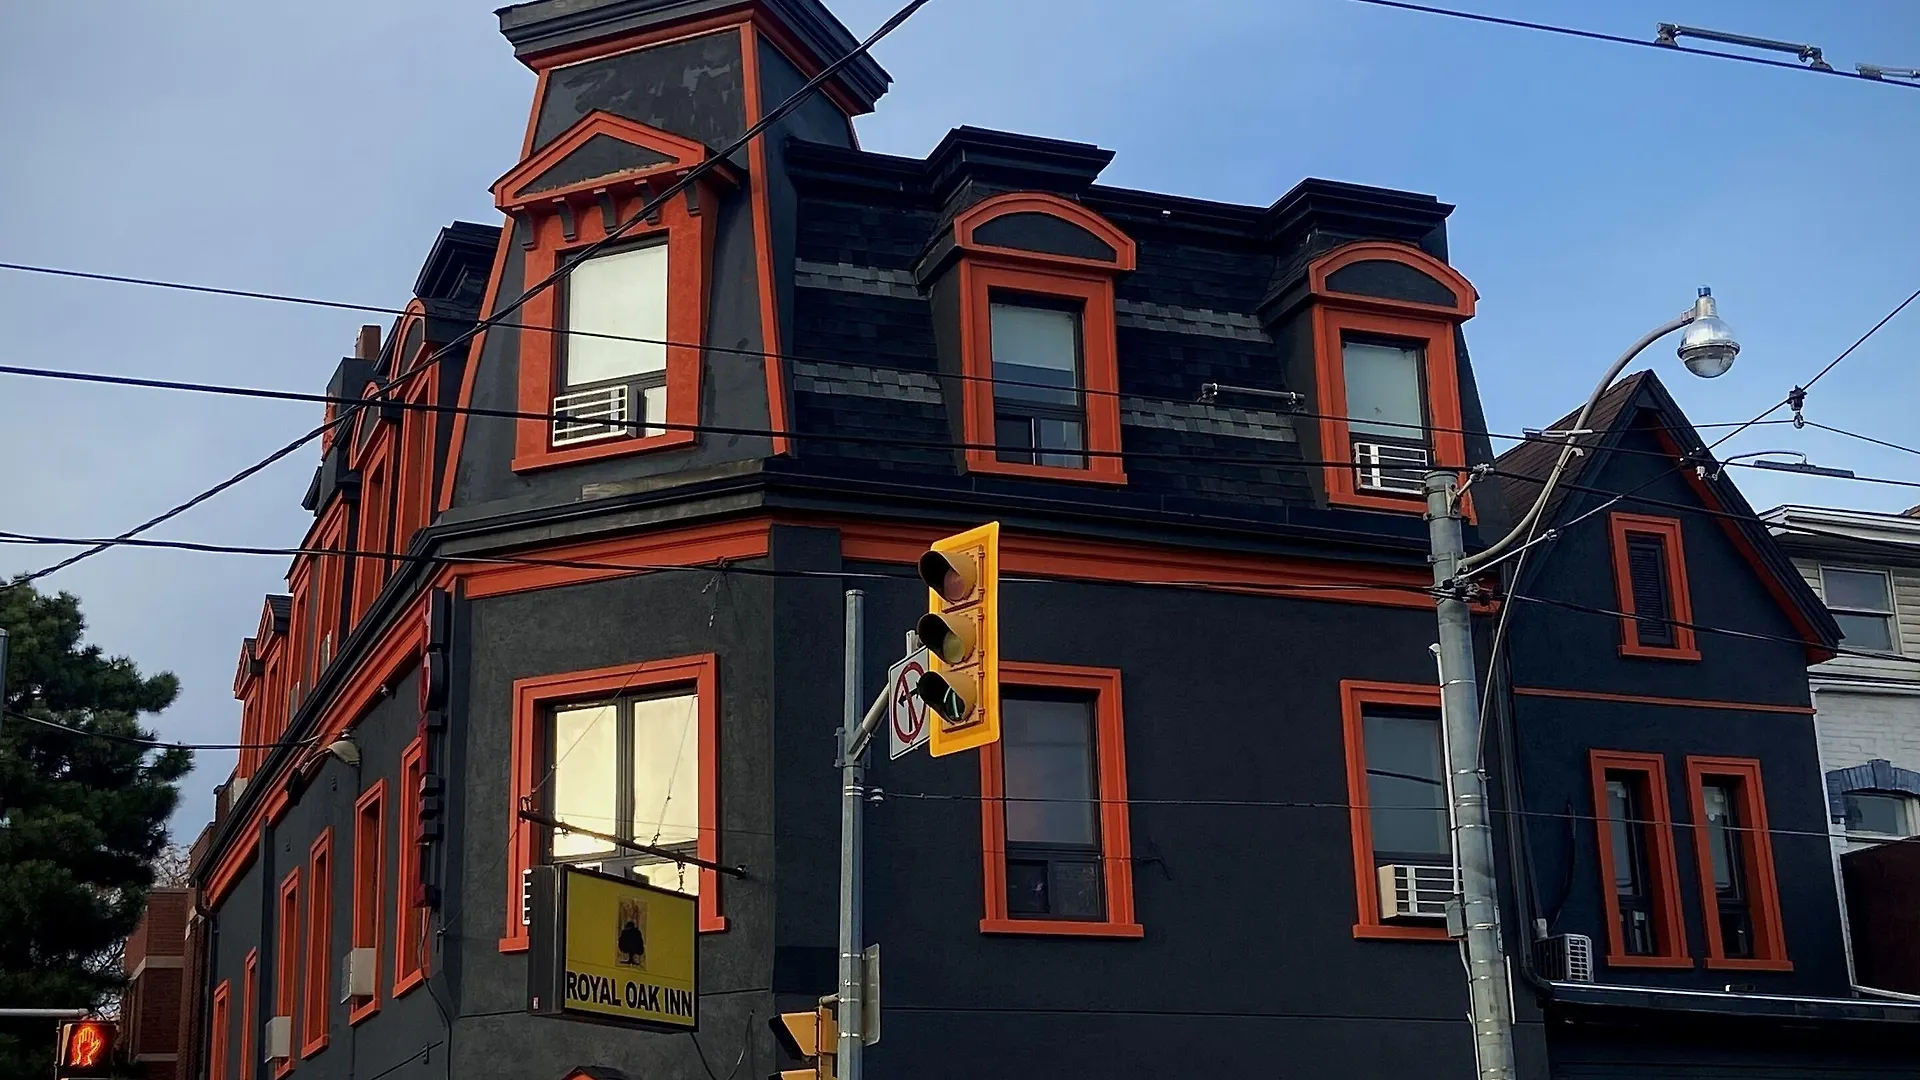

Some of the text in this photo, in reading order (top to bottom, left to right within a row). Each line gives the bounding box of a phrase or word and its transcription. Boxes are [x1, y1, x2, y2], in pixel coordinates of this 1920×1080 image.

[566, 971, 692, 1017] ROYAL OAK INN
